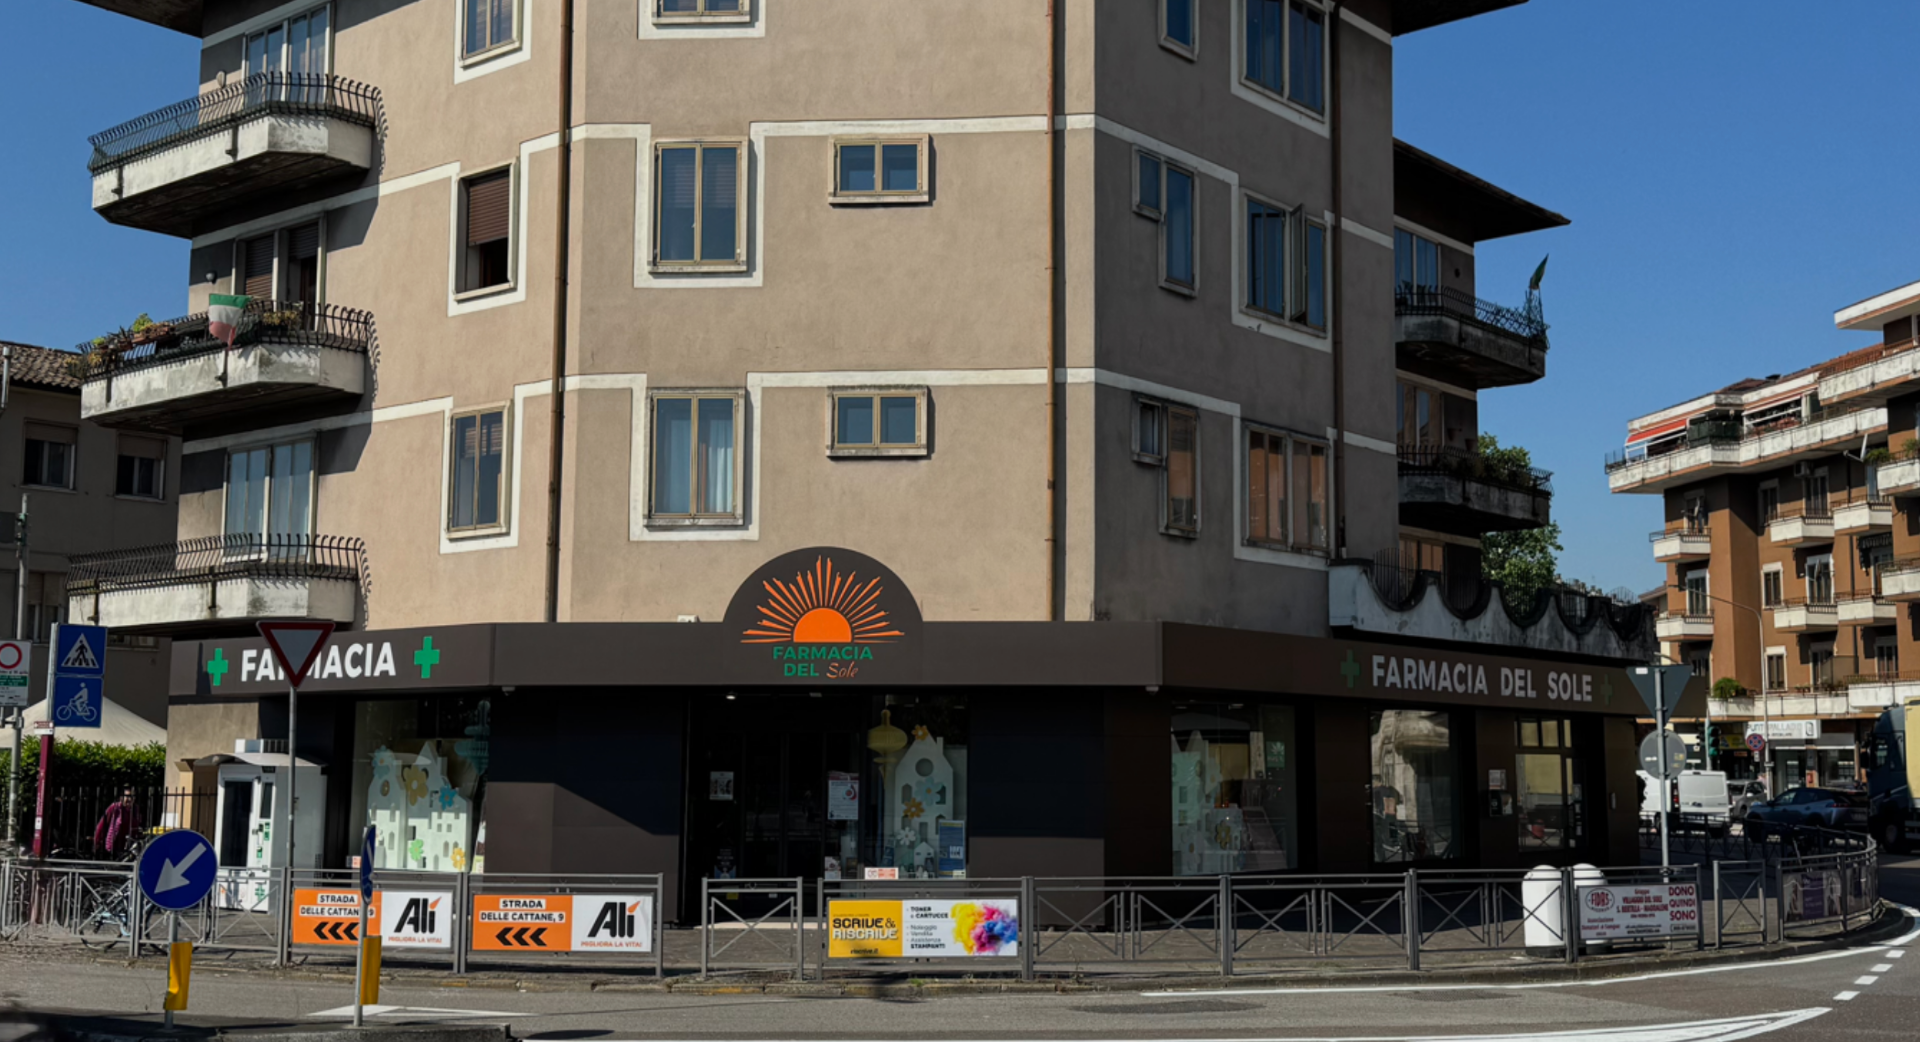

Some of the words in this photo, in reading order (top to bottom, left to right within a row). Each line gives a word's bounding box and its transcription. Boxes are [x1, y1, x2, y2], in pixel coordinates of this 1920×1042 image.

[773, 646, 873, 660] FARMACIA
[784, 663, 819, 677] DEL
[826, 661, 859, 679] Sole
[1372, 655, 1488, 695] FARMACIA
[1500, 666, 1537, 698] DEL
[1547, 671, 1593, 702] SOLE
[1668, 885, 1694, 896] DONO
[319, 895, 356, 904] STRADA
[502, 900, 543, 909] STRADA
[1669, 898, 1696, 908] QUINDI
[300, 907, 327, 916] DELLE
[1669, 910, 1696, 921] SONO
[480, 912, 509, 921] DELLE
[511, 912, 556, 923] CATTANE,
[558, 913, 564, 922] 9
[832, 918, 884, 929] SCRIVE
[885, 917, 896, 929] &
[832, 928, 898, 940] RISCRIVE
